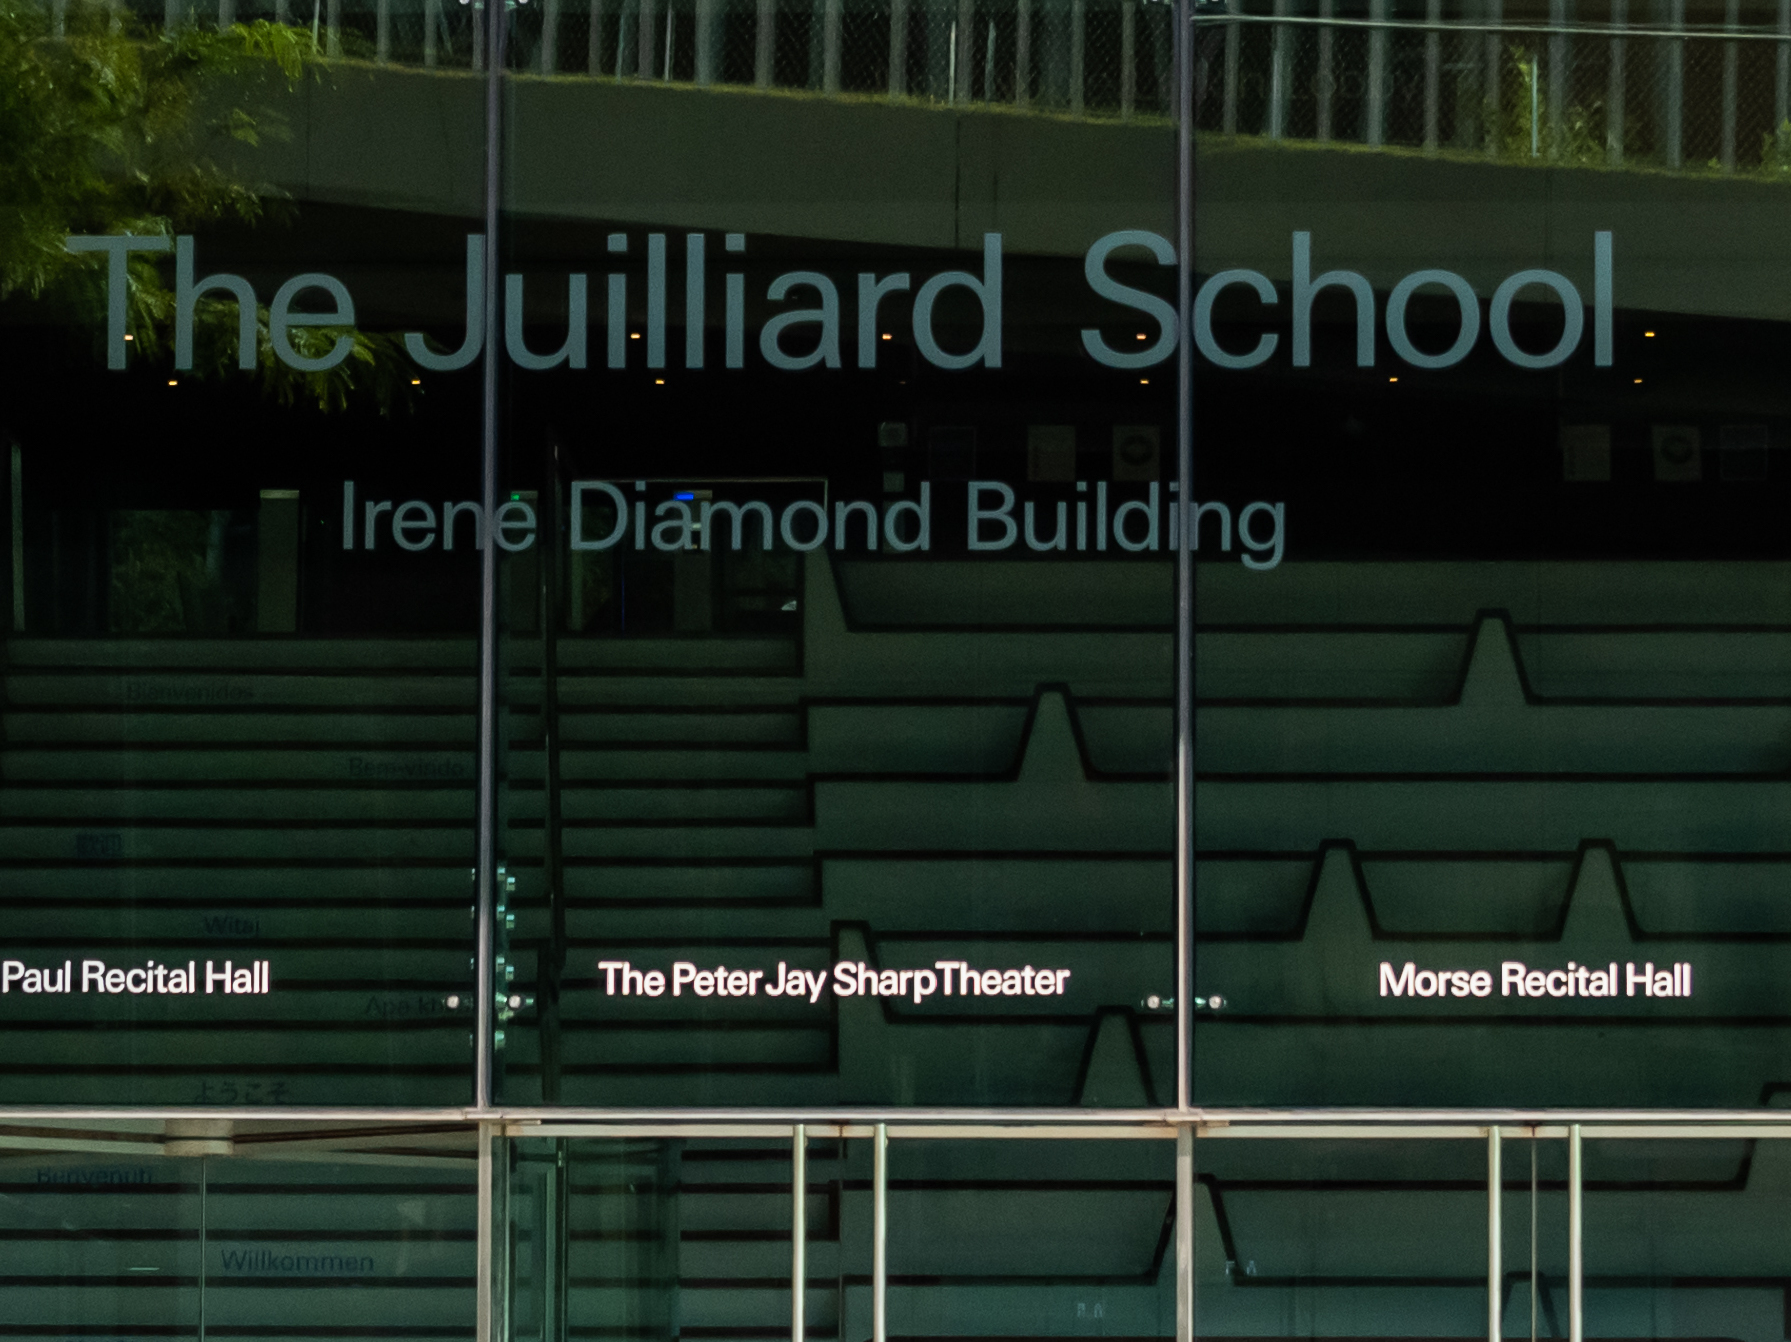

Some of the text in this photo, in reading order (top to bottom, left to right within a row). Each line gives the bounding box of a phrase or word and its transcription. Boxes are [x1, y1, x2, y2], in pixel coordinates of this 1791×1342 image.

[63, 228, 1616, 372] The Juilliard School
[341, 479, 1288, 569] Irene Diamond Building
[1, 959, 270, 994] Paul Recital Hall
[597, 961, 666, 996] The
[672, 961, 764, 996] Peter
[764, 961, 828, 1004] Jay
[1378, 960, 1692, 997] Morse Recital Hall
[220, 1248, 376, 1274] Willkommen
